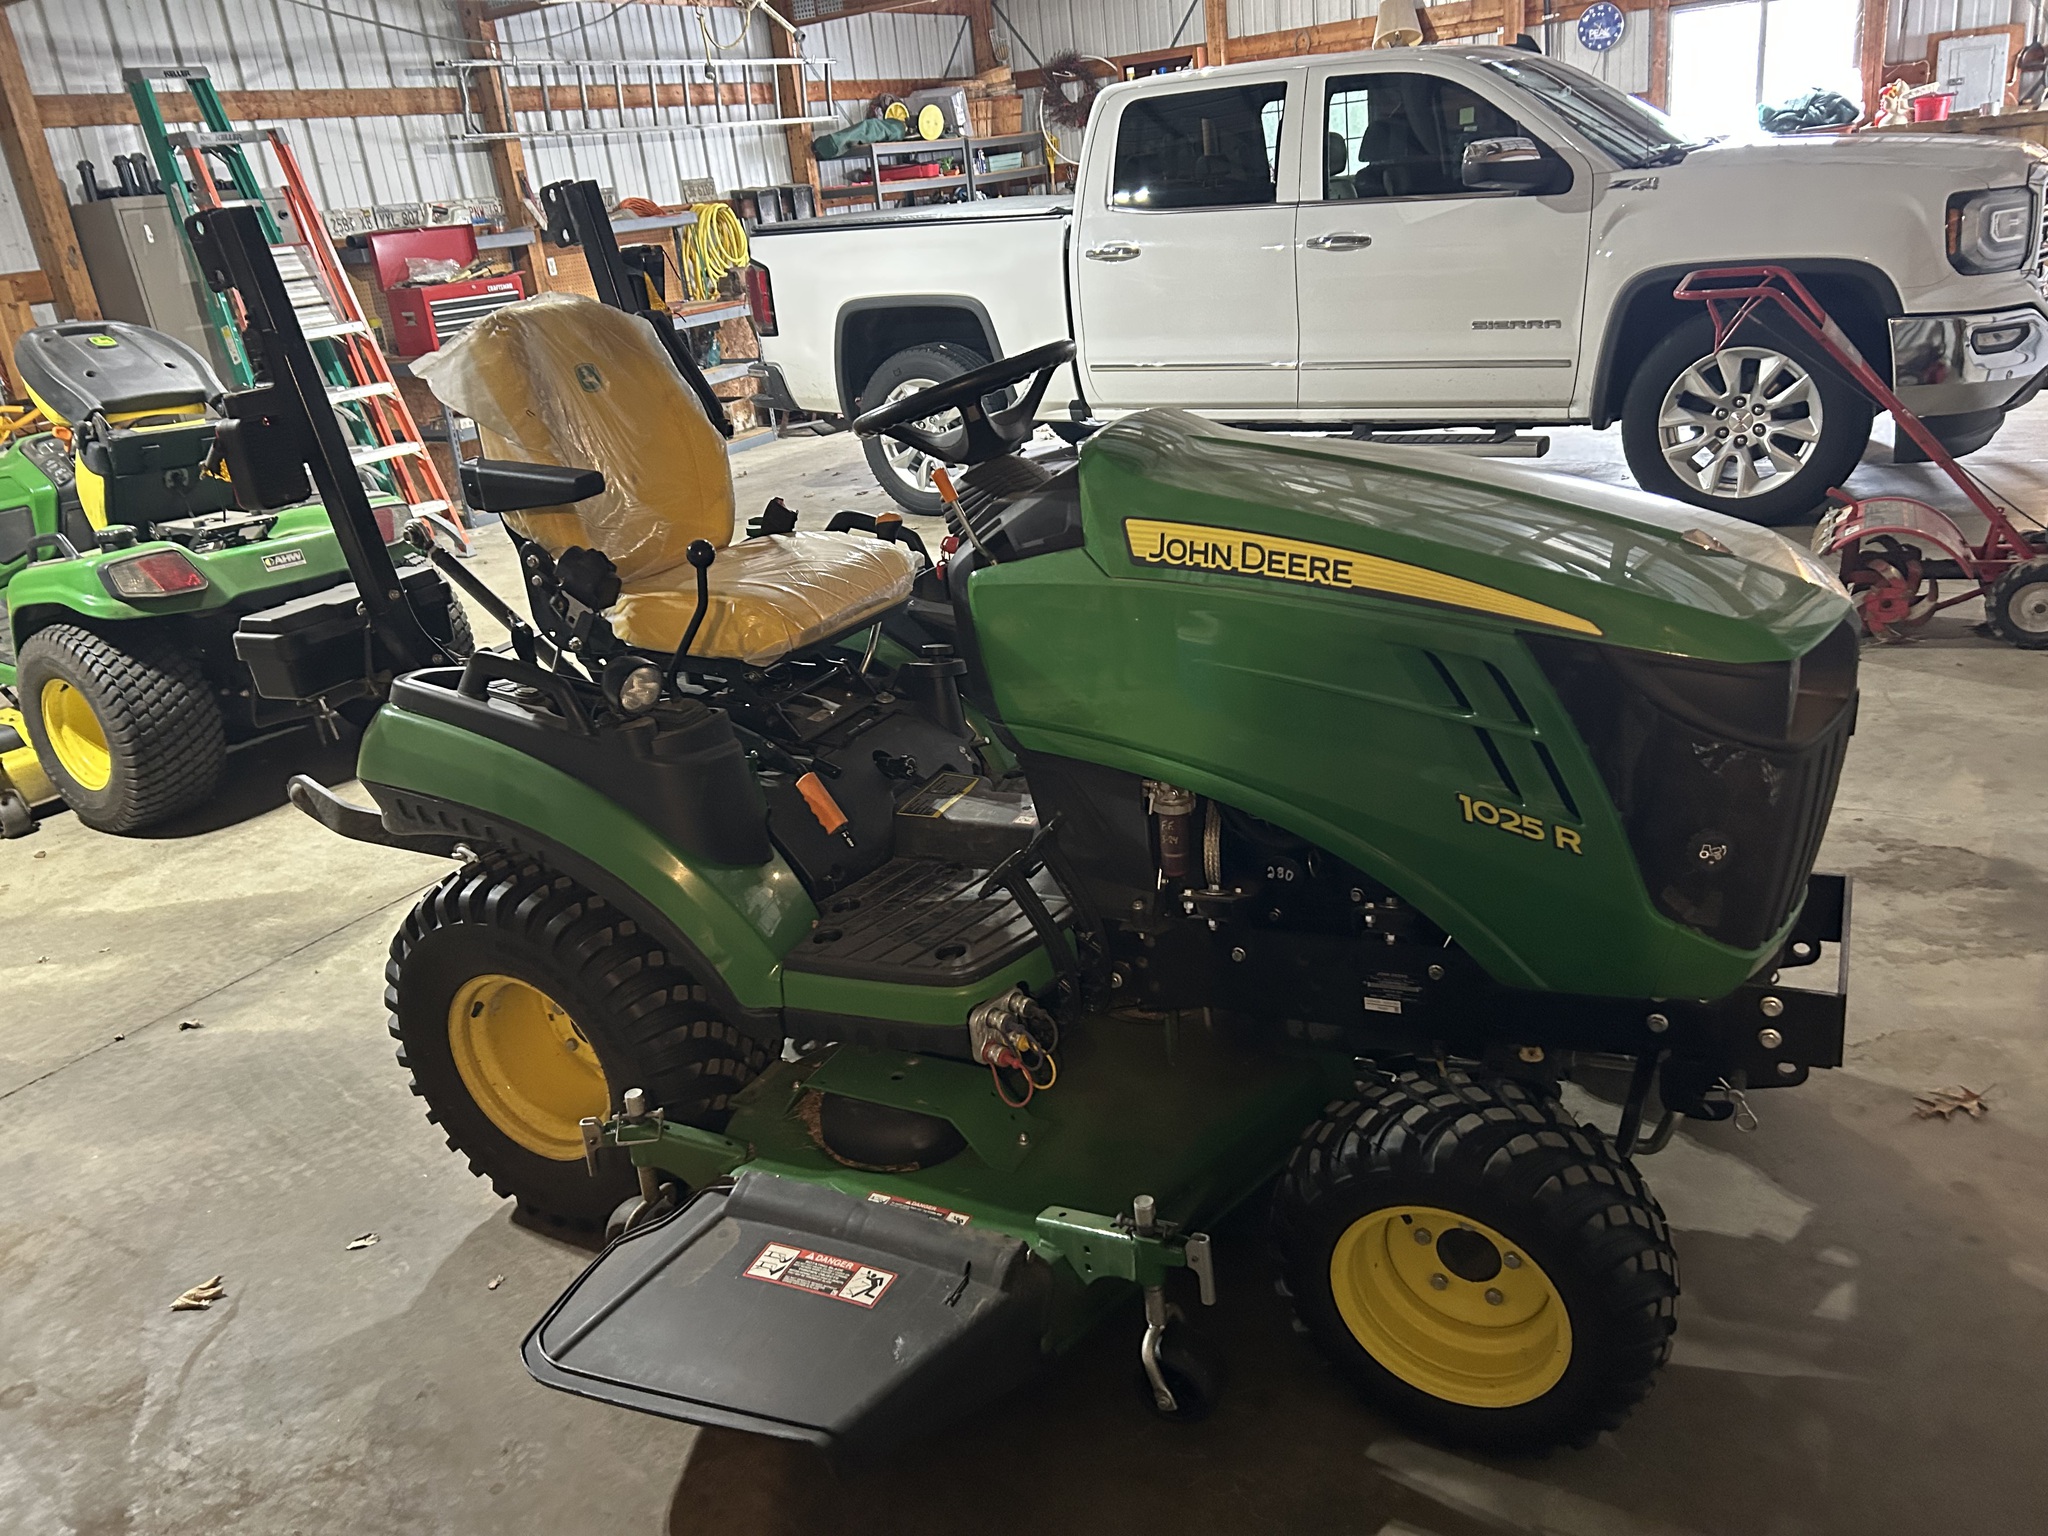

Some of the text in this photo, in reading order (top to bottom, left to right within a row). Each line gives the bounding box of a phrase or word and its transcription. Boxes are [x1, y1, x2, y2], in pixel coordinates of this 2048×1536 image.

[163, 70, 191, 78] KELLER
[215, 133, 243, 141] KELLER
[401, 211, 420, 225] 807
[487, 283, 514, 292] CRAFTSMAN
[1472, 319, 1562, 330] SIERRA
[275, 551, 302, 565] AHW
[1149, 532, 1353, 584] JOHN DEERE
[1457, 793, 1583, 855] 1025 R
[911, 1201, 937, 1211] DANGER
[815, 1254, 855, 1270] DANGER
